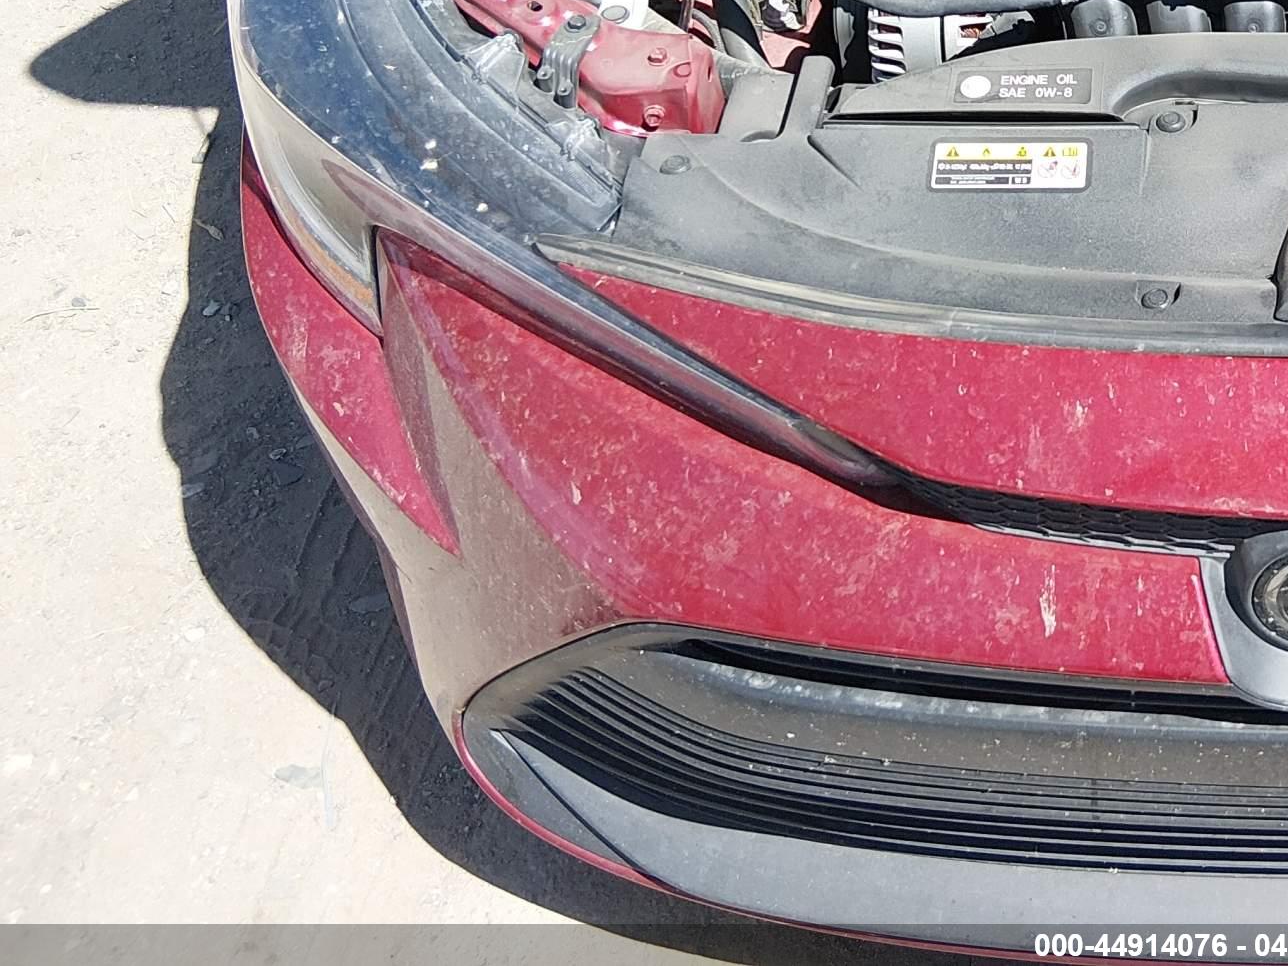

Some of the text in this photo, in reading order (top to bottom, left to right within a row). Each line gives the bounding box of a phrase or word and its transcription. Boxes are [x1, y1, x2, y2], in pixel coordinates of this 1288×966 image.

[1000, 74, 1077, 85] ENGINE OIL
[999, 87, 1073, 98] SAE 0W-8
